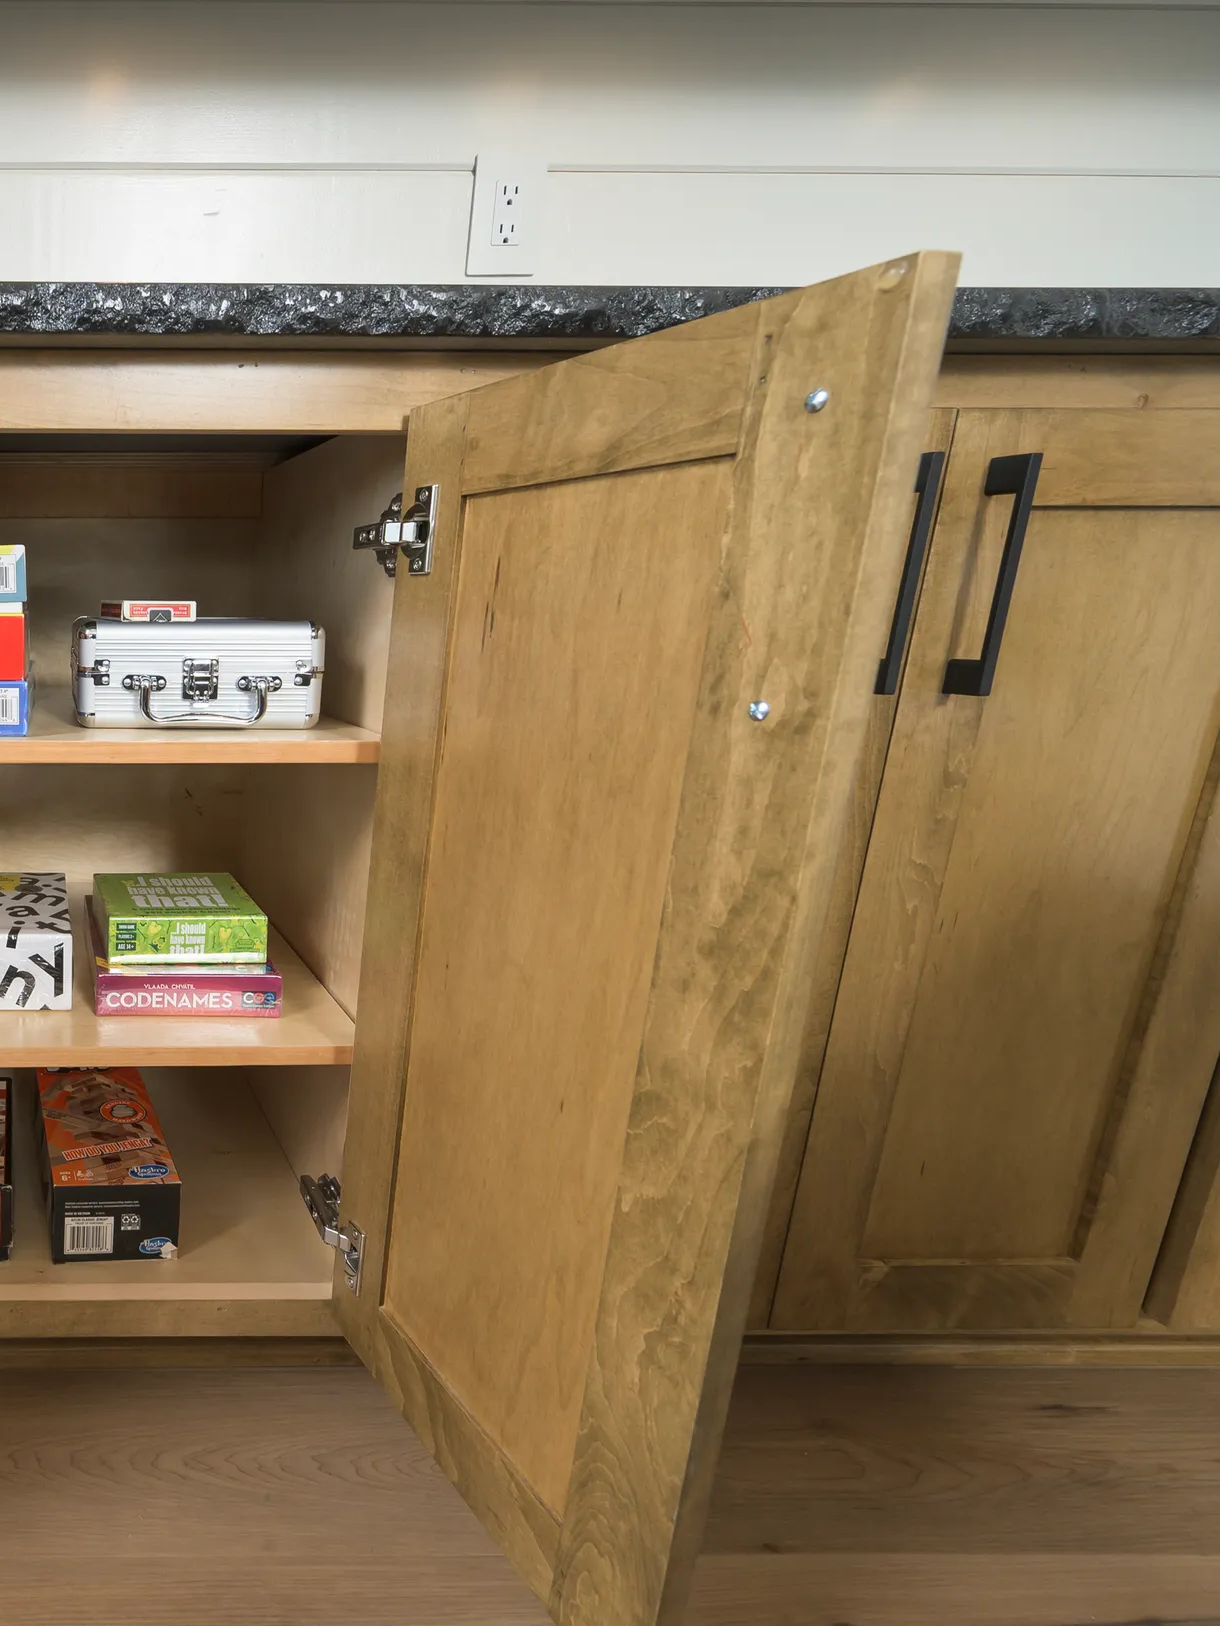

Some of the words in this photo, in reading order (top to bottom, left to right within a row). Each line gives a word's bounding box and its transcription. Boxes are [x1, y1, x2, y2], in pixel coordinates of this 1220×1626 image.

[150, 877, 214, 886] should
[127, 886, 166, 895] have
[166, 886, 221, 895] known
[131, 894, 229, 907] that!
[180, 922, 206, 934] should
[170, 935, 184, 944] have
[186, 935, 206, 944] known
[106, 992, 233, 1008] CODENAMES
[64, 1148, 87, 1160] HOW
[86, 1146, 100, 1156] DO
[100, 1143, 120, 1153] YOU
[120, 1138, 152, 1150] JENGA?
[144, 1239, 165, 1247] Hasbr
